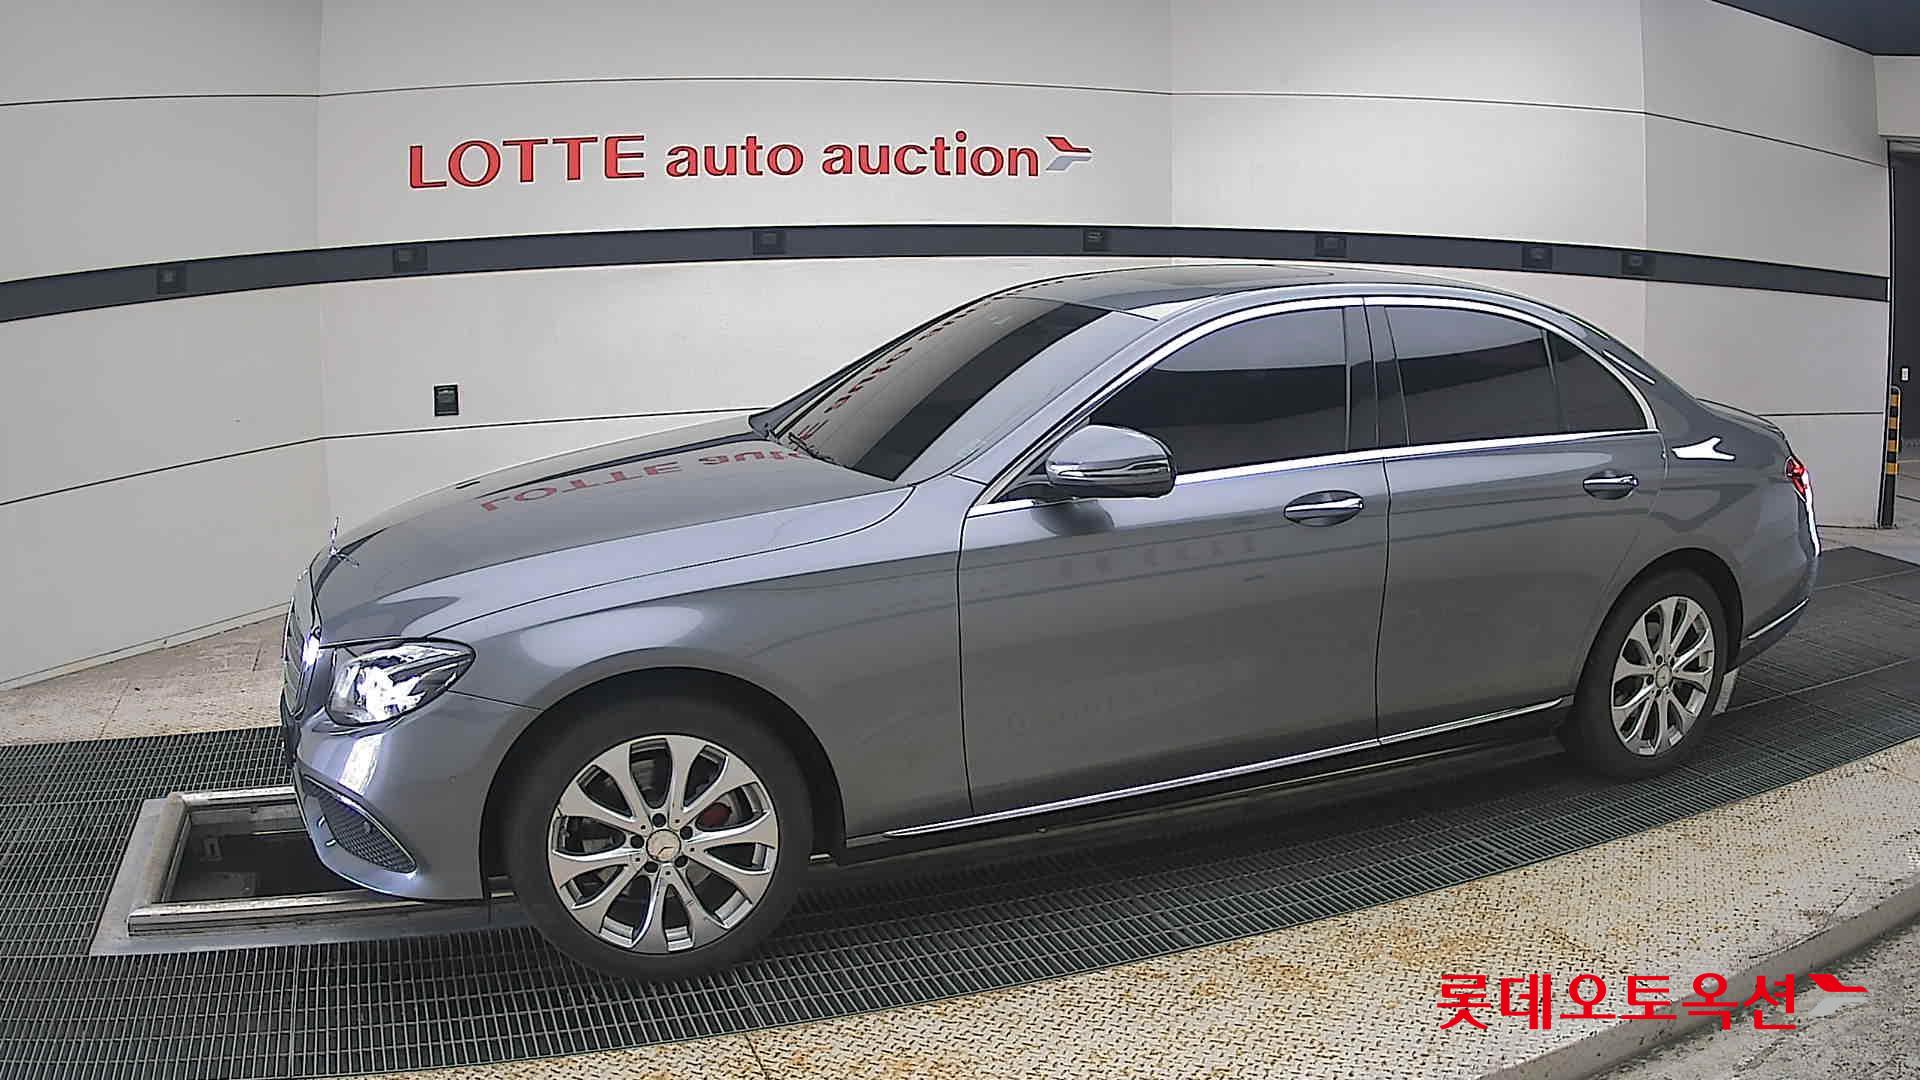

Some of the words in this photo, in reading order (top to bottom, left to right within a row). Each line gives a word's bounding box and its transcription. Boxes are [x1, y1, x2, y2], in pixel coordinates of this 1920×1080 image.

[409, 135, 645, 189] LOTTE
[665, 135, 804, 176] auto
[821, 130, 1039, 177] auction
